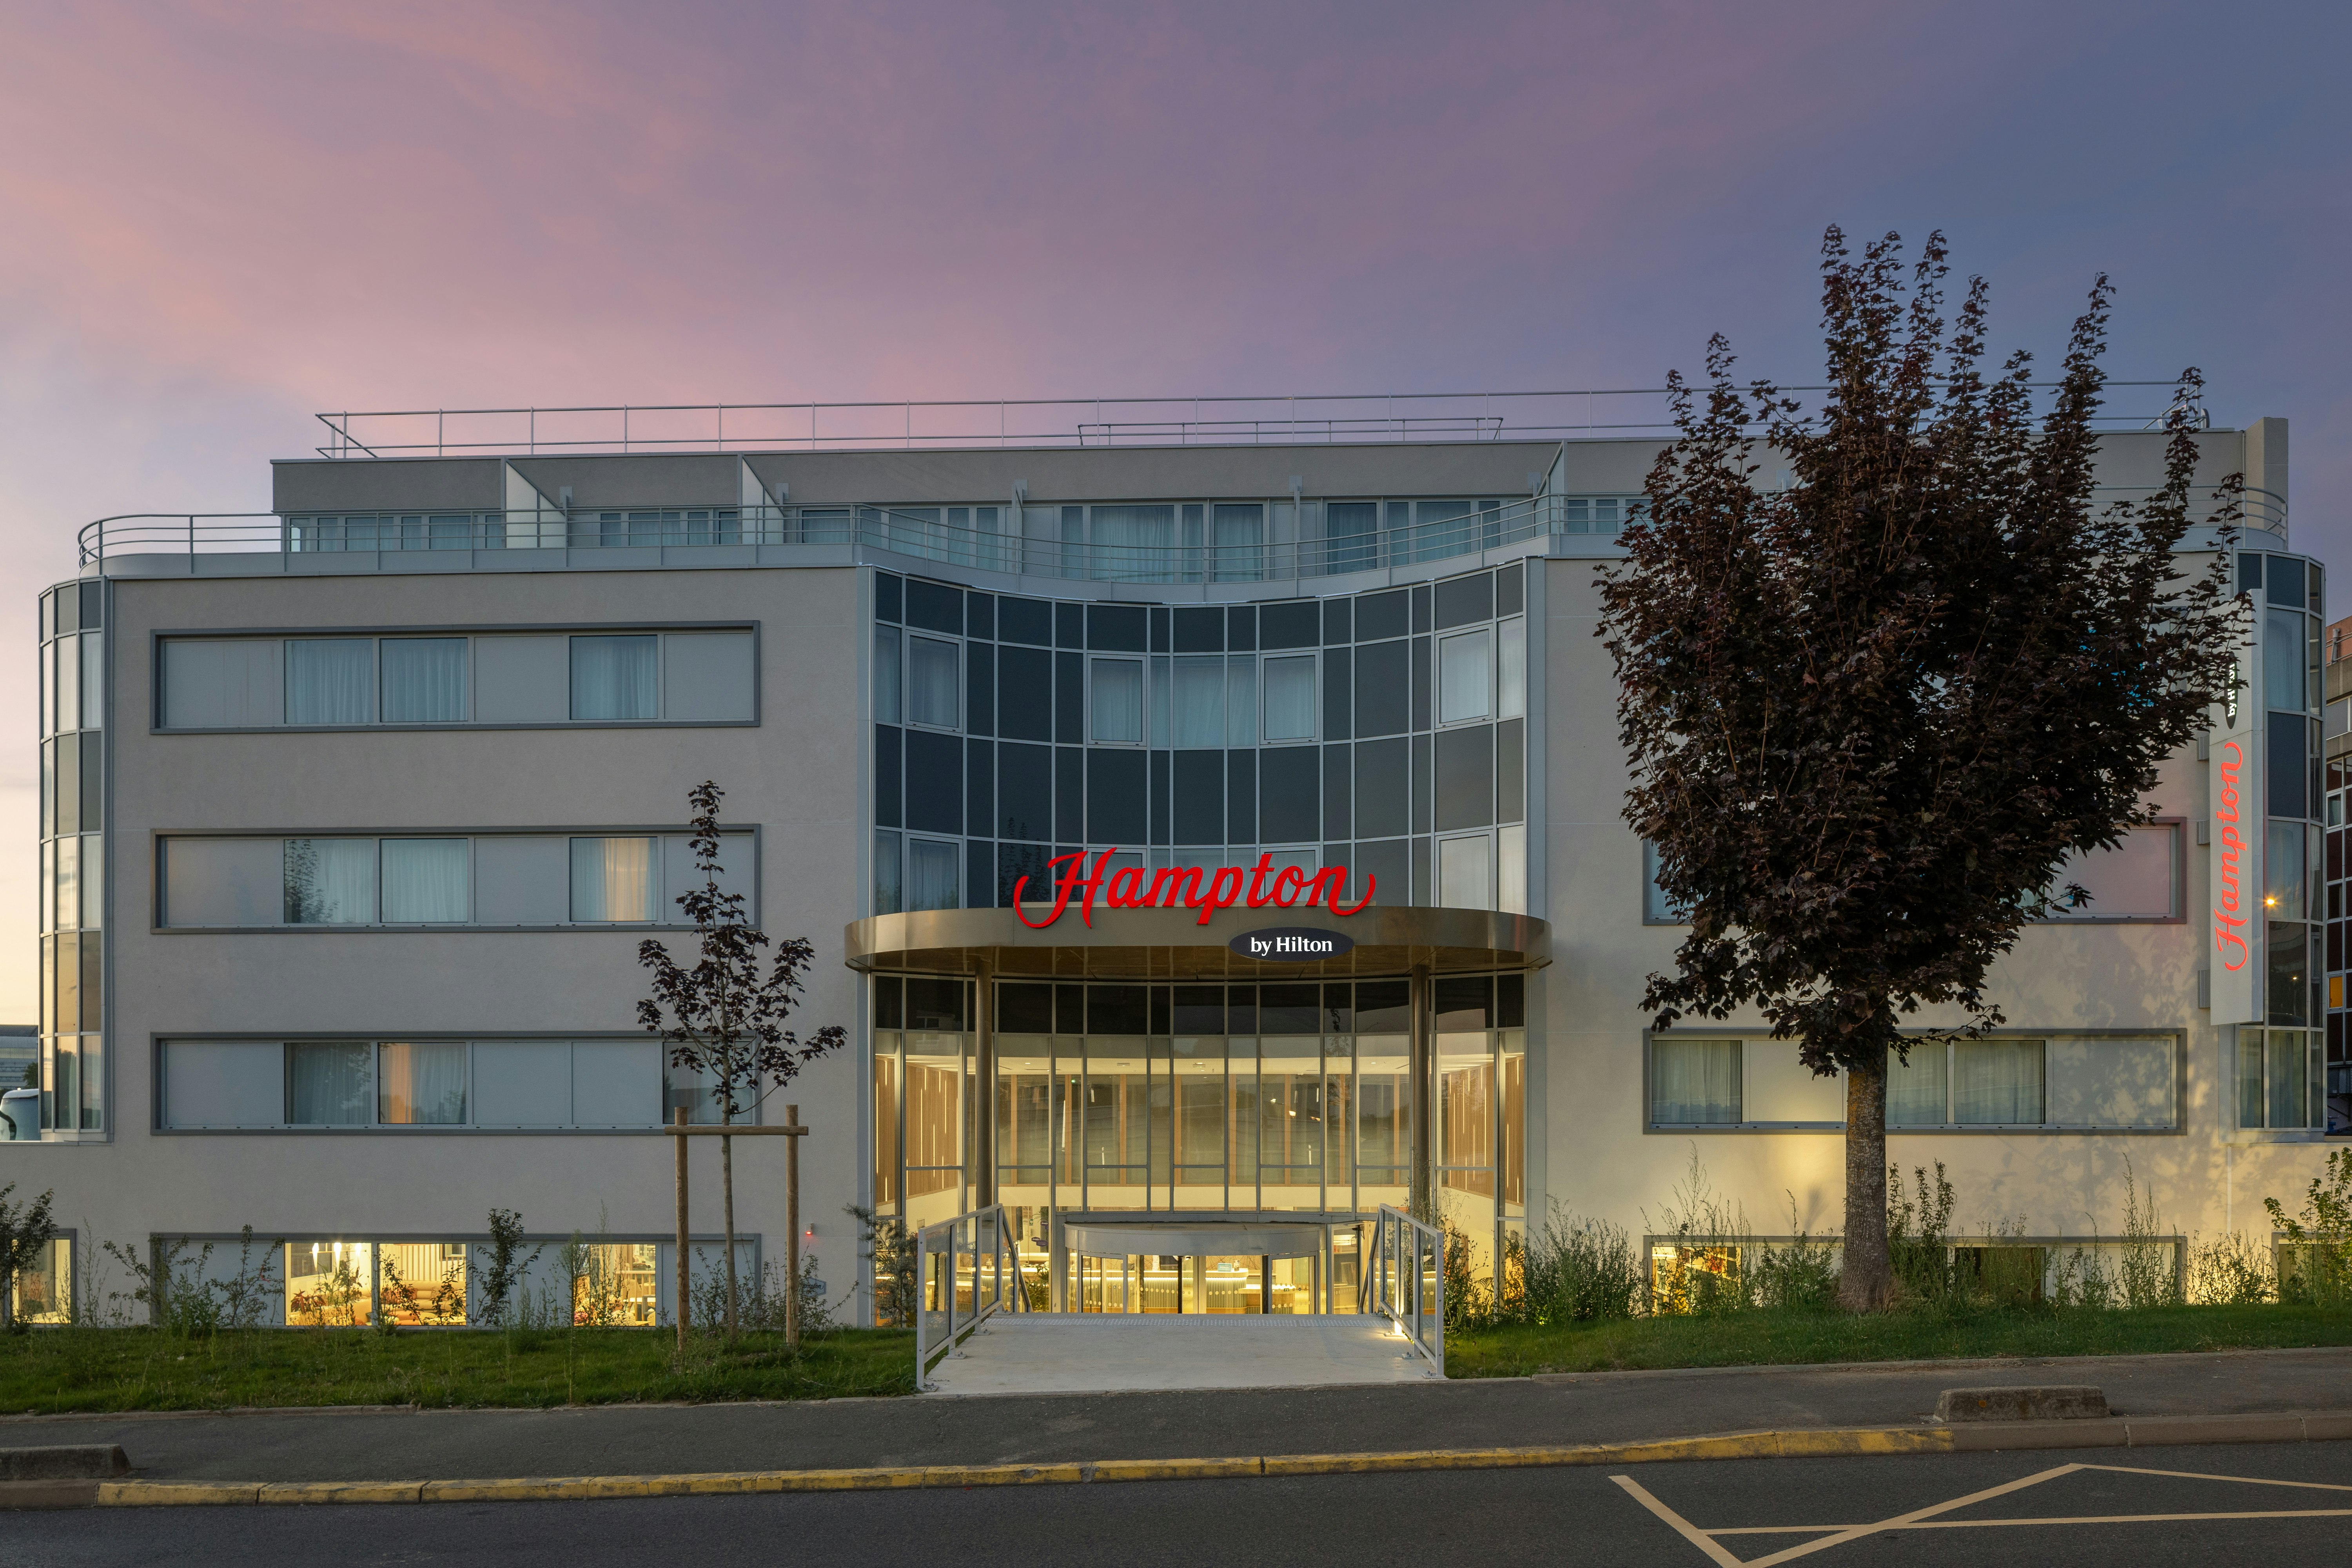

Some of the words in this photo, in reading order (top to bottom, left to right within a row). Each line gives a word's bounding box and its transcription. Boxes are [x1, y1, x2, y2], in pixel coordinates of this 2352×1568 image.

[2227, 702, 2237, 717] by
[2214, 742, 2248, 971] Hampton
[1013, 847, 1376, 928] Hampton
[1250, 937, 1272, 956] by
[1276, 936, 1333, 952] Hilton
